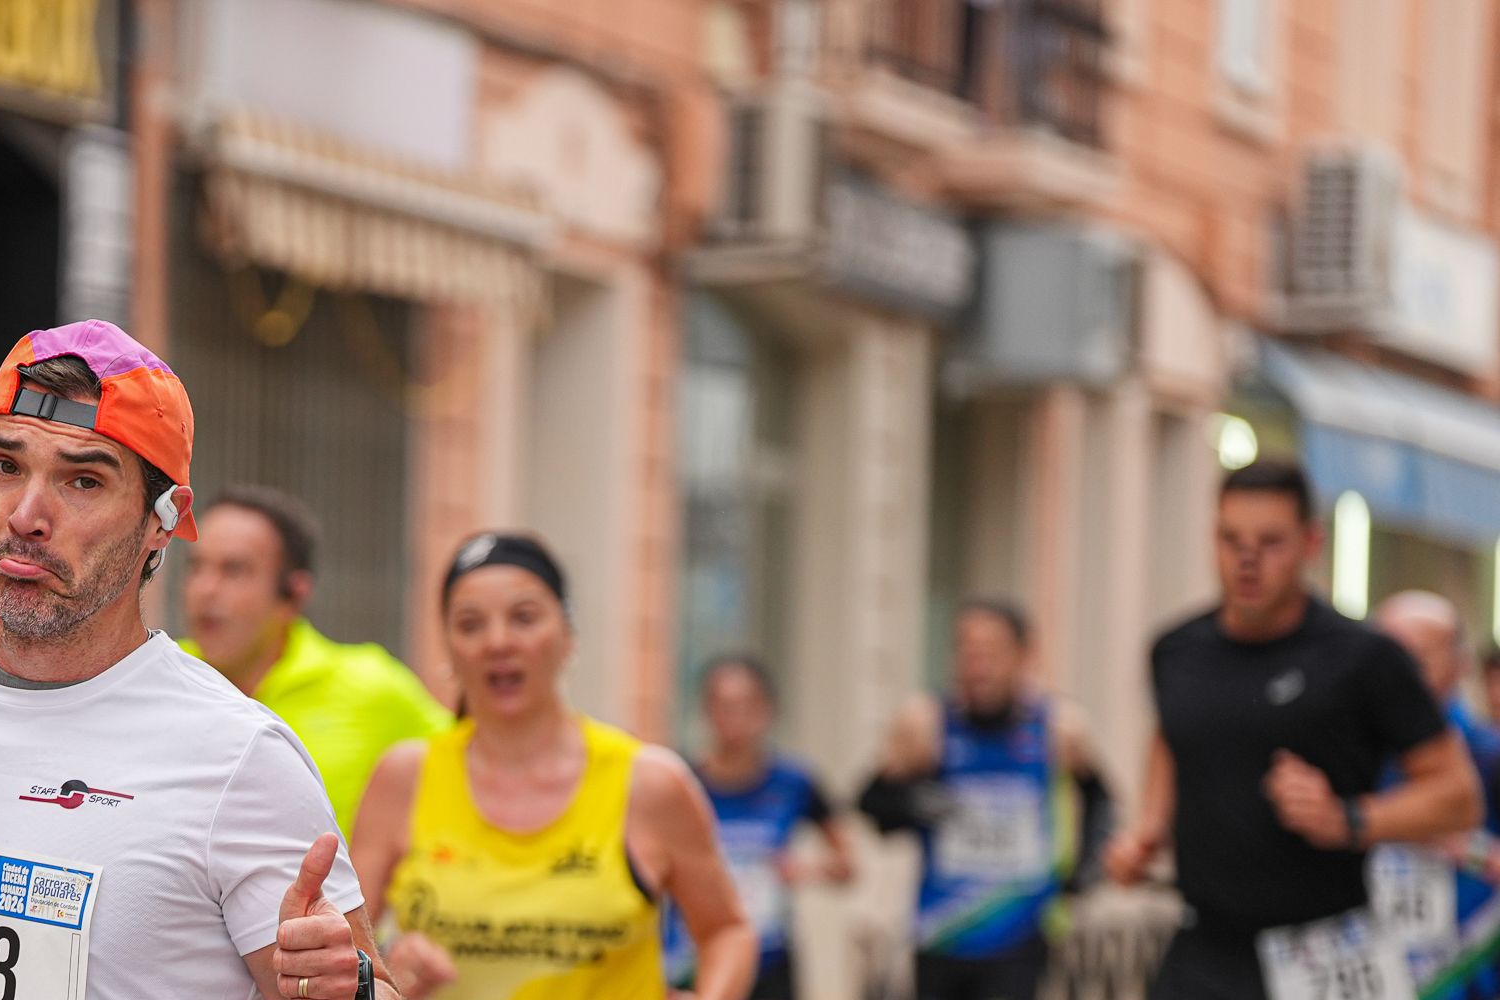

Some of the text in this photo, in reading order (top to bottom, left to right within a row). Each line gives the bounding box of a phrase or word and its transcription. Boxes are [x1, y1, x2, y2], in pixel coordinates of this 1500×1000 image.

[29, 785, 121, 808] STAFF SPORT
[2, 862, 30, 875] Ciudad de
[1, 870, 28, 886] LUCENA
[34, 876, 76, 892] carreras
[31, 884, 82, 902] populares
